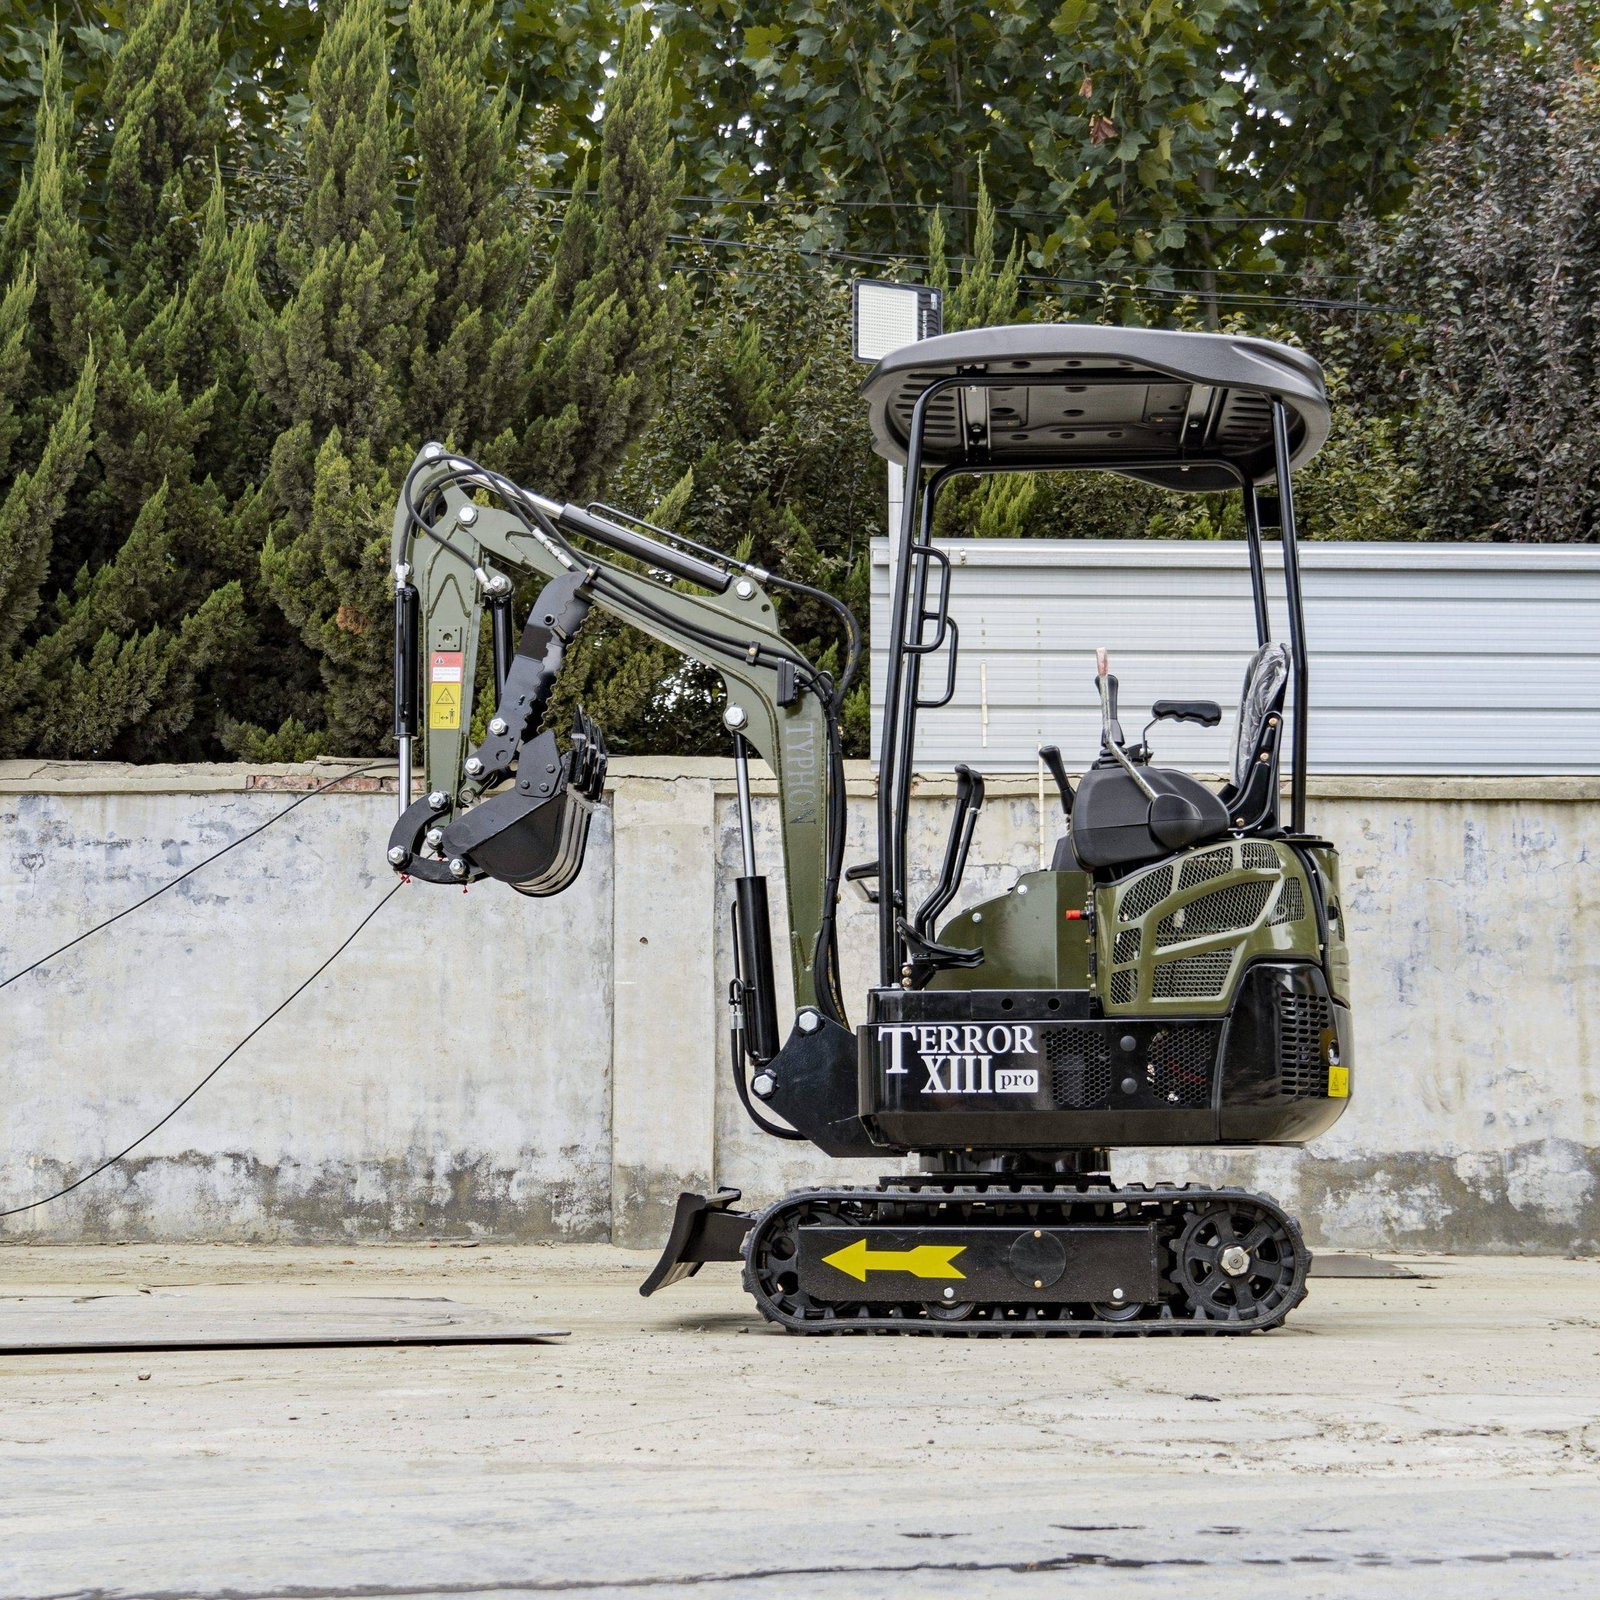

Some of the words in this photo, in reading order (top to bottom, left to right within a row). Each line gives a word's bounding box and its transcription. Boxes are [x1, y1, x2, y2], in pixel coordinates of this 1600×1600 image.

[786, 721, 816, 824] TYPHON
[878, 1026, 1038, 1074] TERROR
[920, 1055, 993, 1094] XIII
[1001, 1074, 1034, 1090] pro
